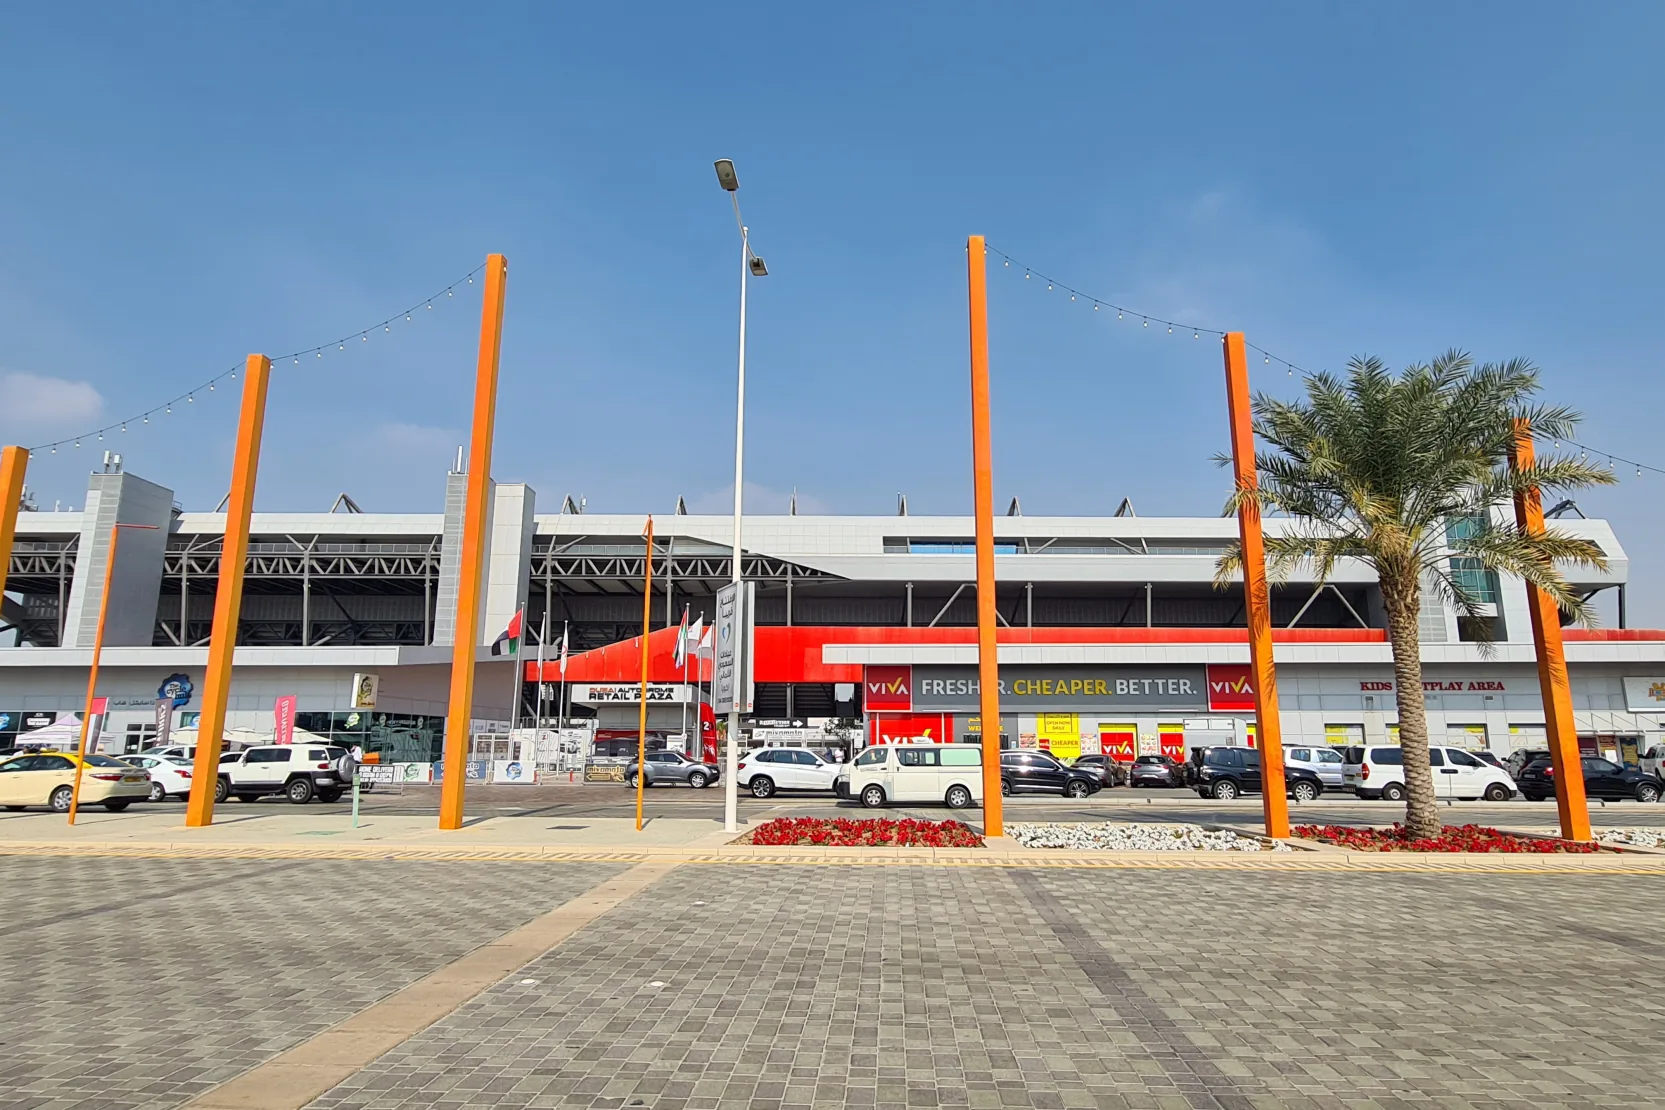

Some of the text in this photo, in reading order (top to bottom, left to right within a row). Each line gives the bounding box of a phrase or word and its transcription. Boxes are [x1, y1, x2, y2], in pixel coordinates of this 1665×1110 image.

[868, 677, 909, 695] VIVA
[921, 679, 1198, 695] FRESHR. CHEAPER. BETTER.
[1210, 676, 1254, 694] VIVA
[1360, 682, 1393, 691] KIDS
[1468, 681, 1505, 691] AREA
[1103, 741, 1133, 754] VIVA
